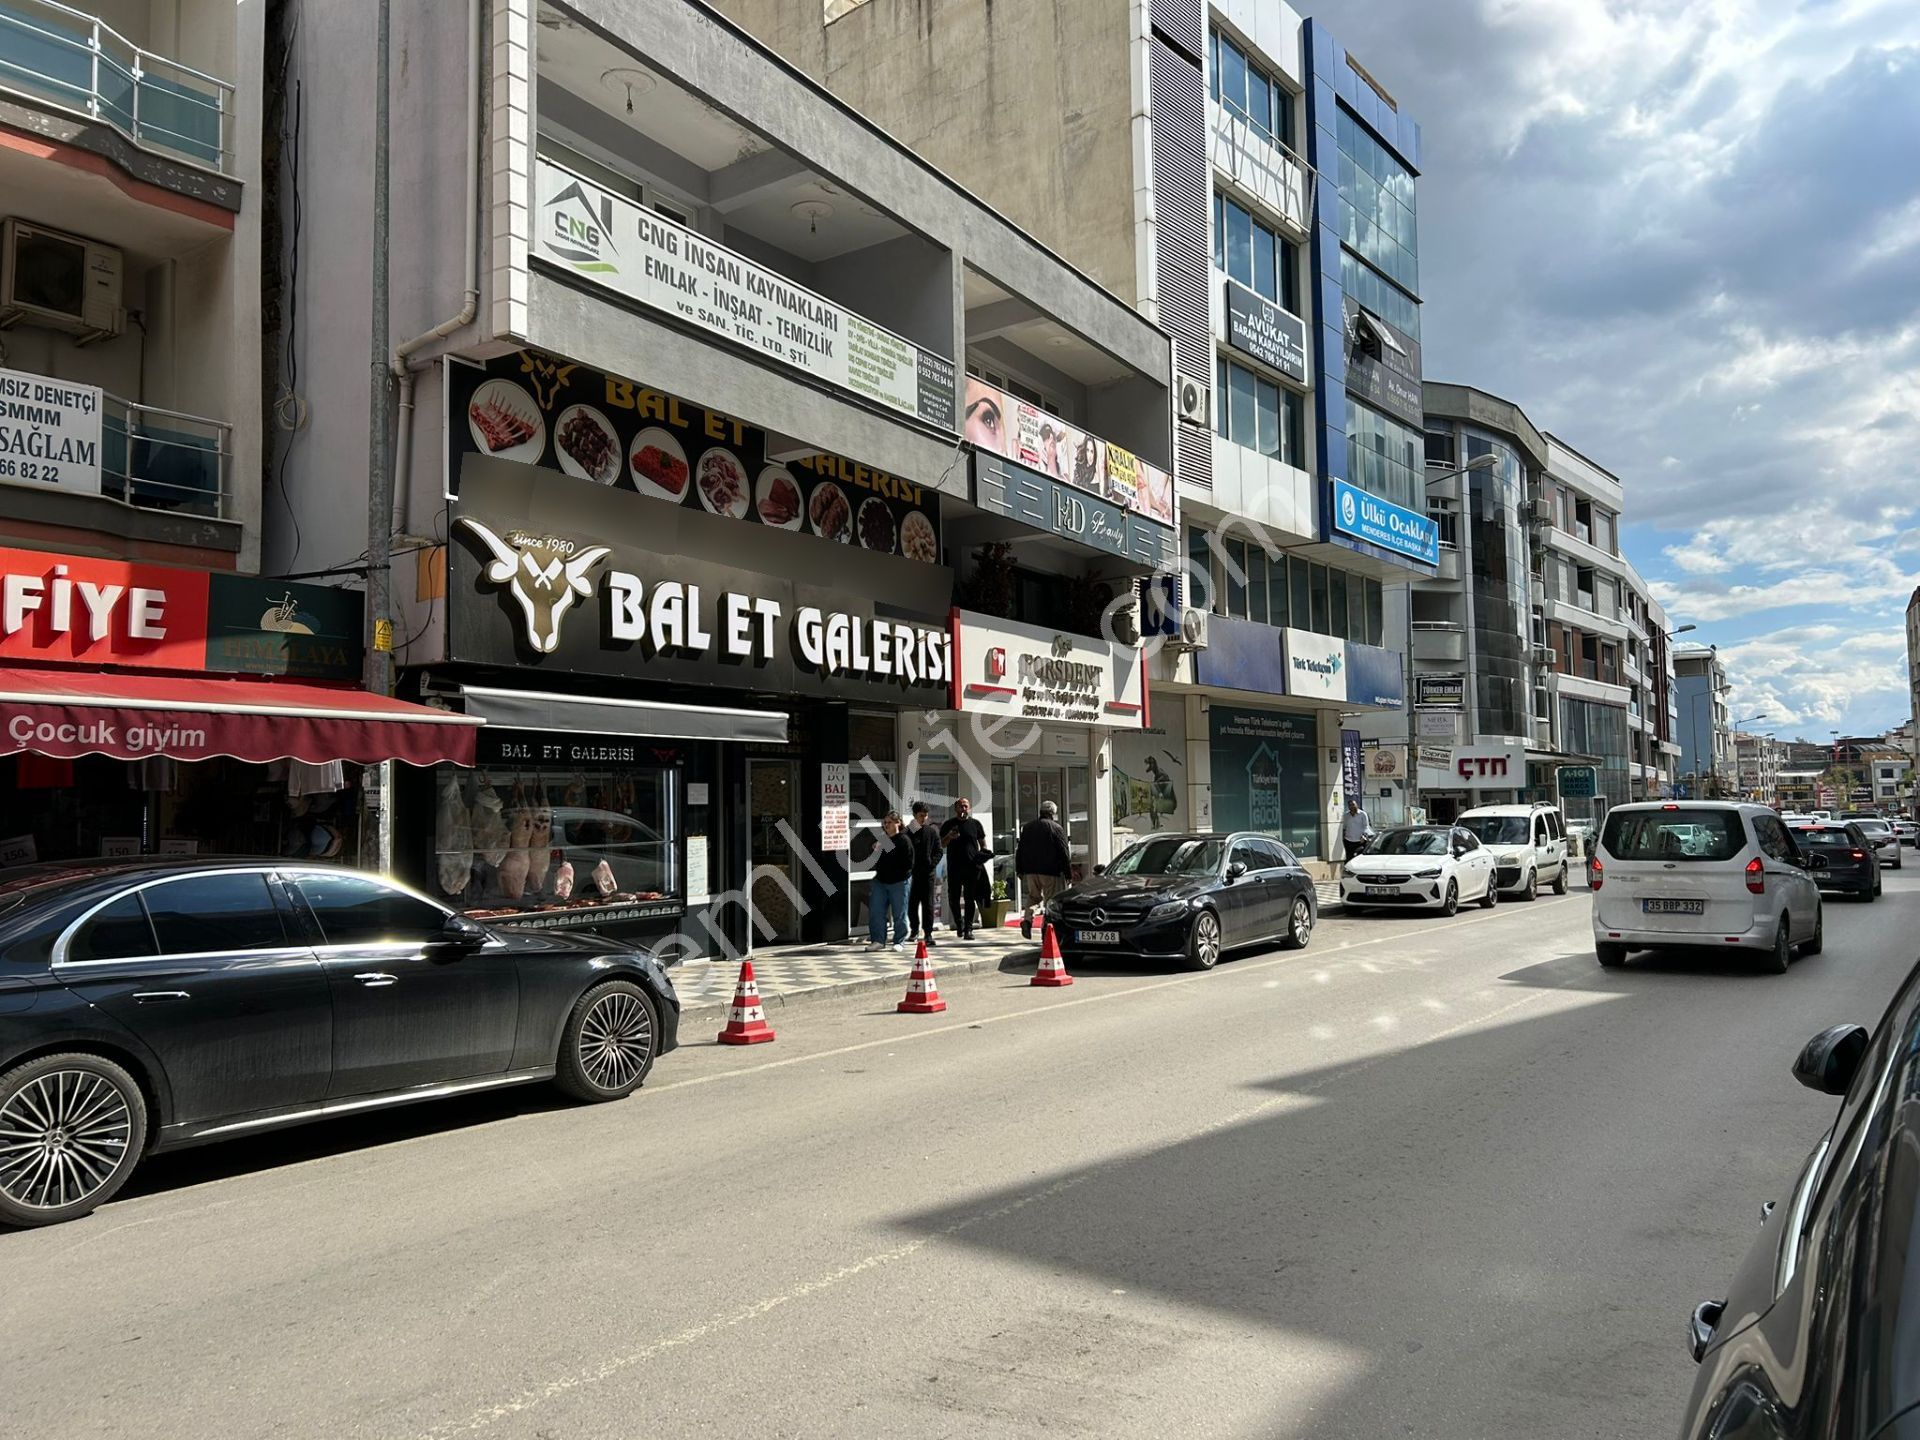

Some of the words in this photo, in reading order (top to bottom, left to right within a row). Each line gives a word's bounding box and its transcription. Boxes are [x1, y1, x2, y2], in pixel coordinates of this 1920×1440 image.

[555, 211, 600, 247] CNG
[637, 216, 678, 256] CNG
[684, 233, 741, 287] İNSAN
[745, 273, 838, 333] KAYNAKLARI
[644, 255, 697, 298] EMLAK
[713, 282, 763, 327] İNŞAAT
[776, 315, 833, 358] TEMİZLİK
[677, 300, 694, 315] ve
[698, 306, 730, 333] SAN.
[734, 322, 758, 344] TİC.
[762, 335, 785, 357] LTD.
[790, 346, 811, 367] ŞTİ.
[1233, 320, 1257, 343] BARAN
[1258, 334, 1303, 368] KARAYILDIRIM
[1248, 313, 1289, 347] AVUKAT
[34, 384, 96, 415] DENETÇİ
[605, 375, 689, 429] BAL
[704, 409, 750, 447] ET
[0, 424, 96, 467] SAĞLAM
[20, 462, 37, 479] 82
[41, 465, 59, 483] 22
[1361, 496, 1386, 527] Ülkü
[513, 533, 543, 548] since
[546, 538, 575, 554] 1980
[1361, 523, 1391, 542] MENDERES
[2, 564, 168, 642] FİYE
[608, 571, 711, 653] BAL
[724, 592, 781, 659] ET
[1293, 656, 1306, 671] Türk
[1306, 659, 1332, 674] Telekom
[8, 715, 117, 750] Çocuk
[125, 722, 205, 753] giyim
[502, 743, 531, 758] BAL
[543, 745, 562, 759] ET
[1422, 749, 1450, 759] Toprak
[824, 784, 846, 794] BAL
[1649, 901, 1660, 910] 35
[1682, 901, 1701, 911] 332
[1081, 931, 1096, 941] ESW
[1099, 931, 1116, 941] 768
